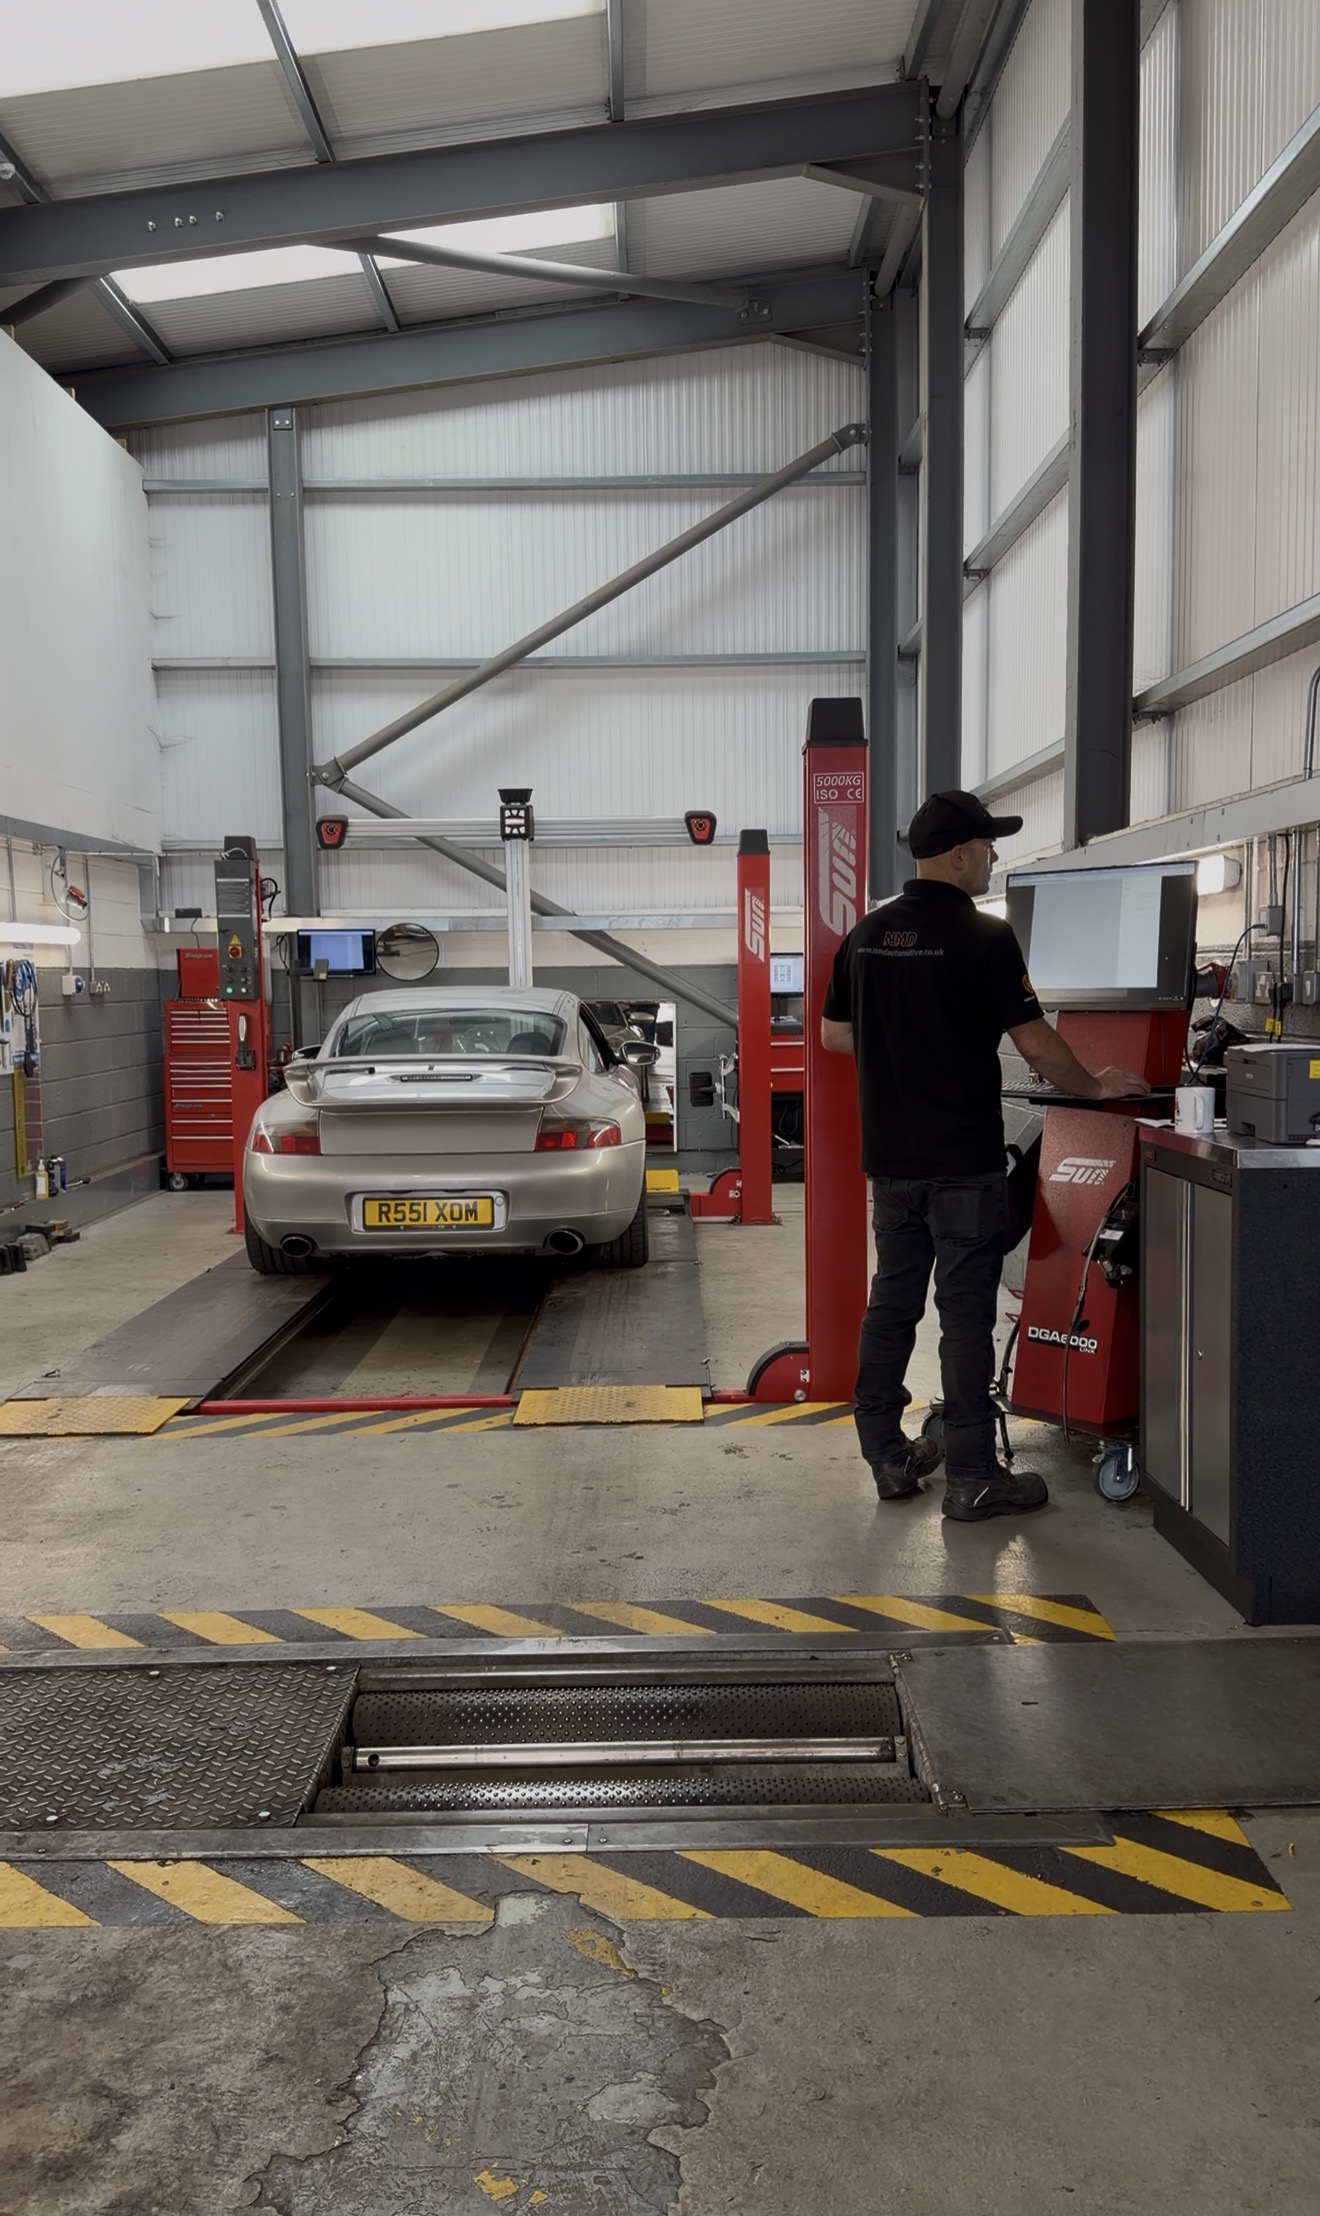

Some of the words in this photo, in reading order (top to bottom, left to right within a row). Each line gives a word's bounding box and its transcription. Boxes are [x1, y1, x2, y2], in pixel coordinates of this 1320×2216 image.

[816, 775, 862, 787] 5000KG
[816, 789, 838, 800] ISO
[883, 931, 918, 947] NMD
[377, 1201, 428, 1223] R551
[434, 1200, 479, 1222] XOM
